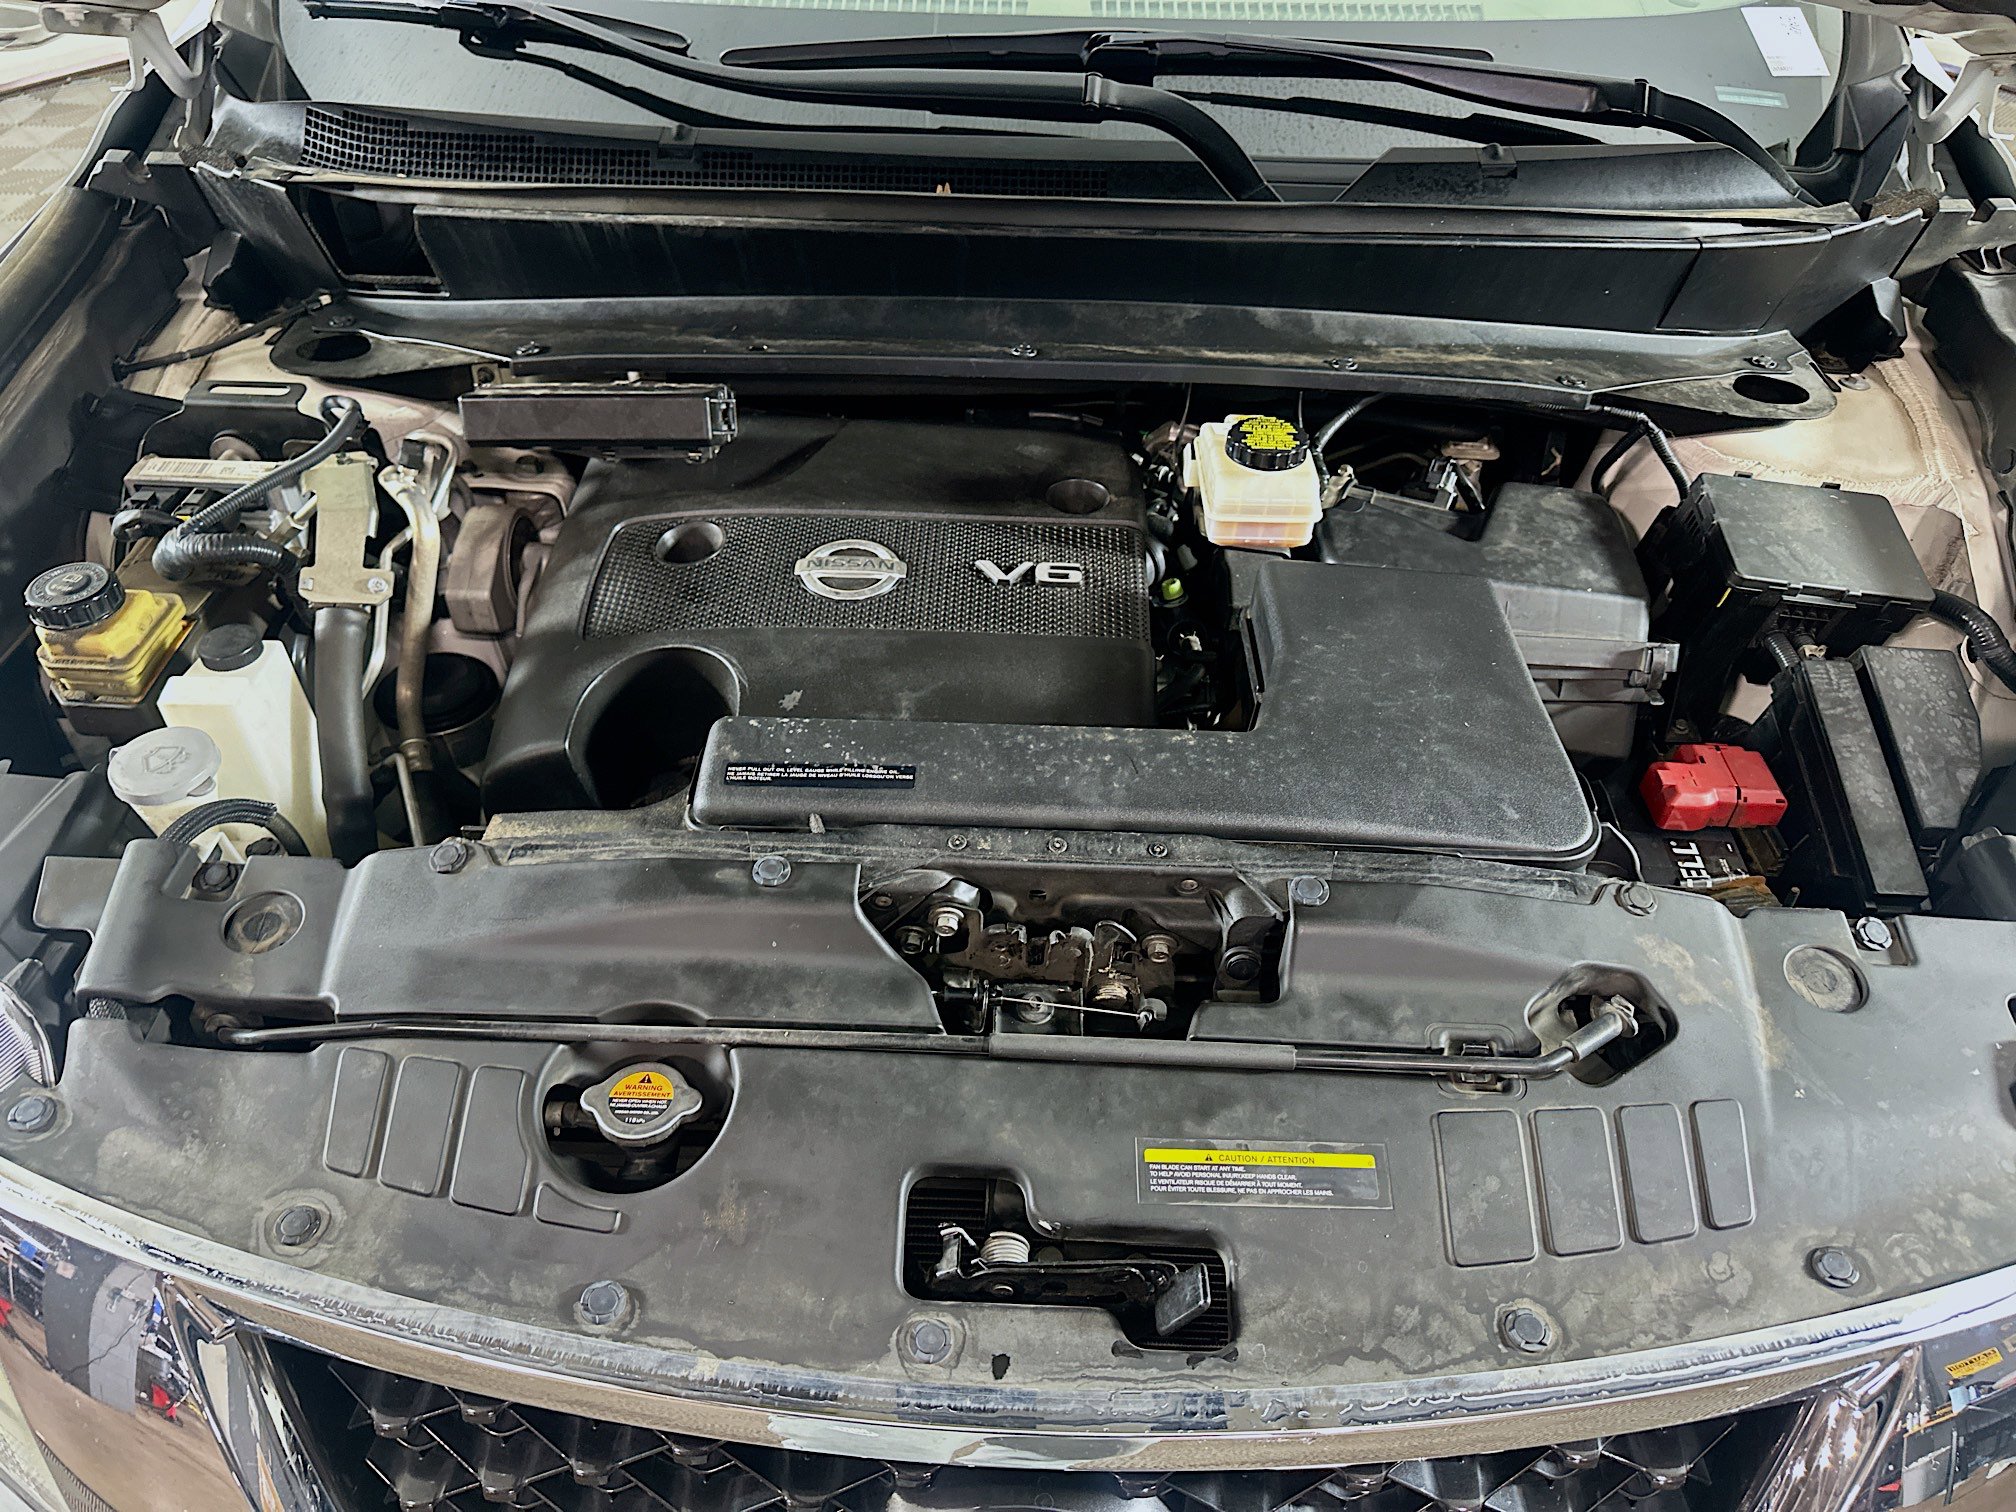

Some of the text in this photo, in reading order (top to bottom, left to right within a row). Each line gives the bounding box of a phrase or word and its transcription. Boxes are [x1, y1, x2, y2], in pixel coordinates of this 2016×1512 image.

[805, 557, 895, 571] NISSAN
[975, 559, 1083, 586] V6
[1219, 1154, 1258, 1162] CAUTION
[1267, 1156, 1315, 1164] ATTENTION
